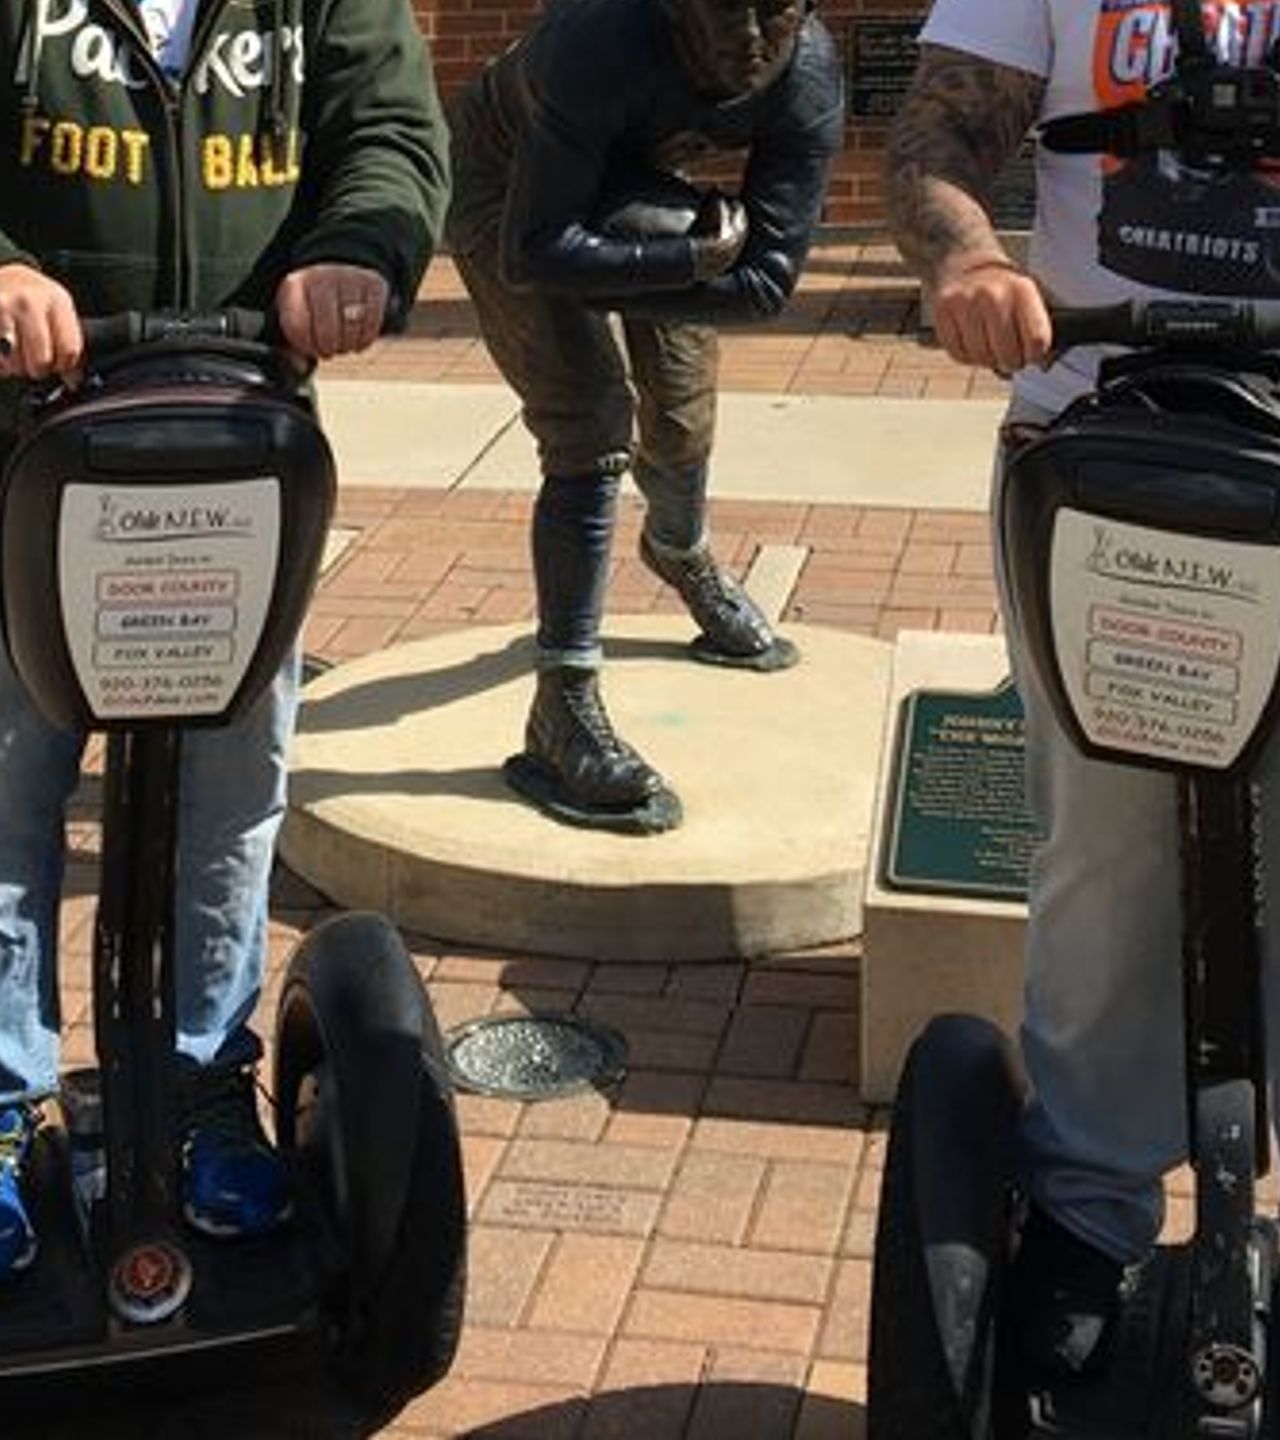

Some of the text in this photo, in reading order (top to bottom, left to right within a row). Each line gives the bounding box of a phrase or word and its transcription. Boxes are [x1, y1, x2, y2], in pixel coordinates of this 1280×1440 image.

[21, 111, 300, 192] FOOT BALL
[179, 613, 211, 627] BAY
[1157, 626, 1229, 650] COUNTY
[155, 645, 215, 658] VALLEY
[1177, 663, 1211, 681] BAY
[1107, 683, 1215, 712] FOX VALLEY
